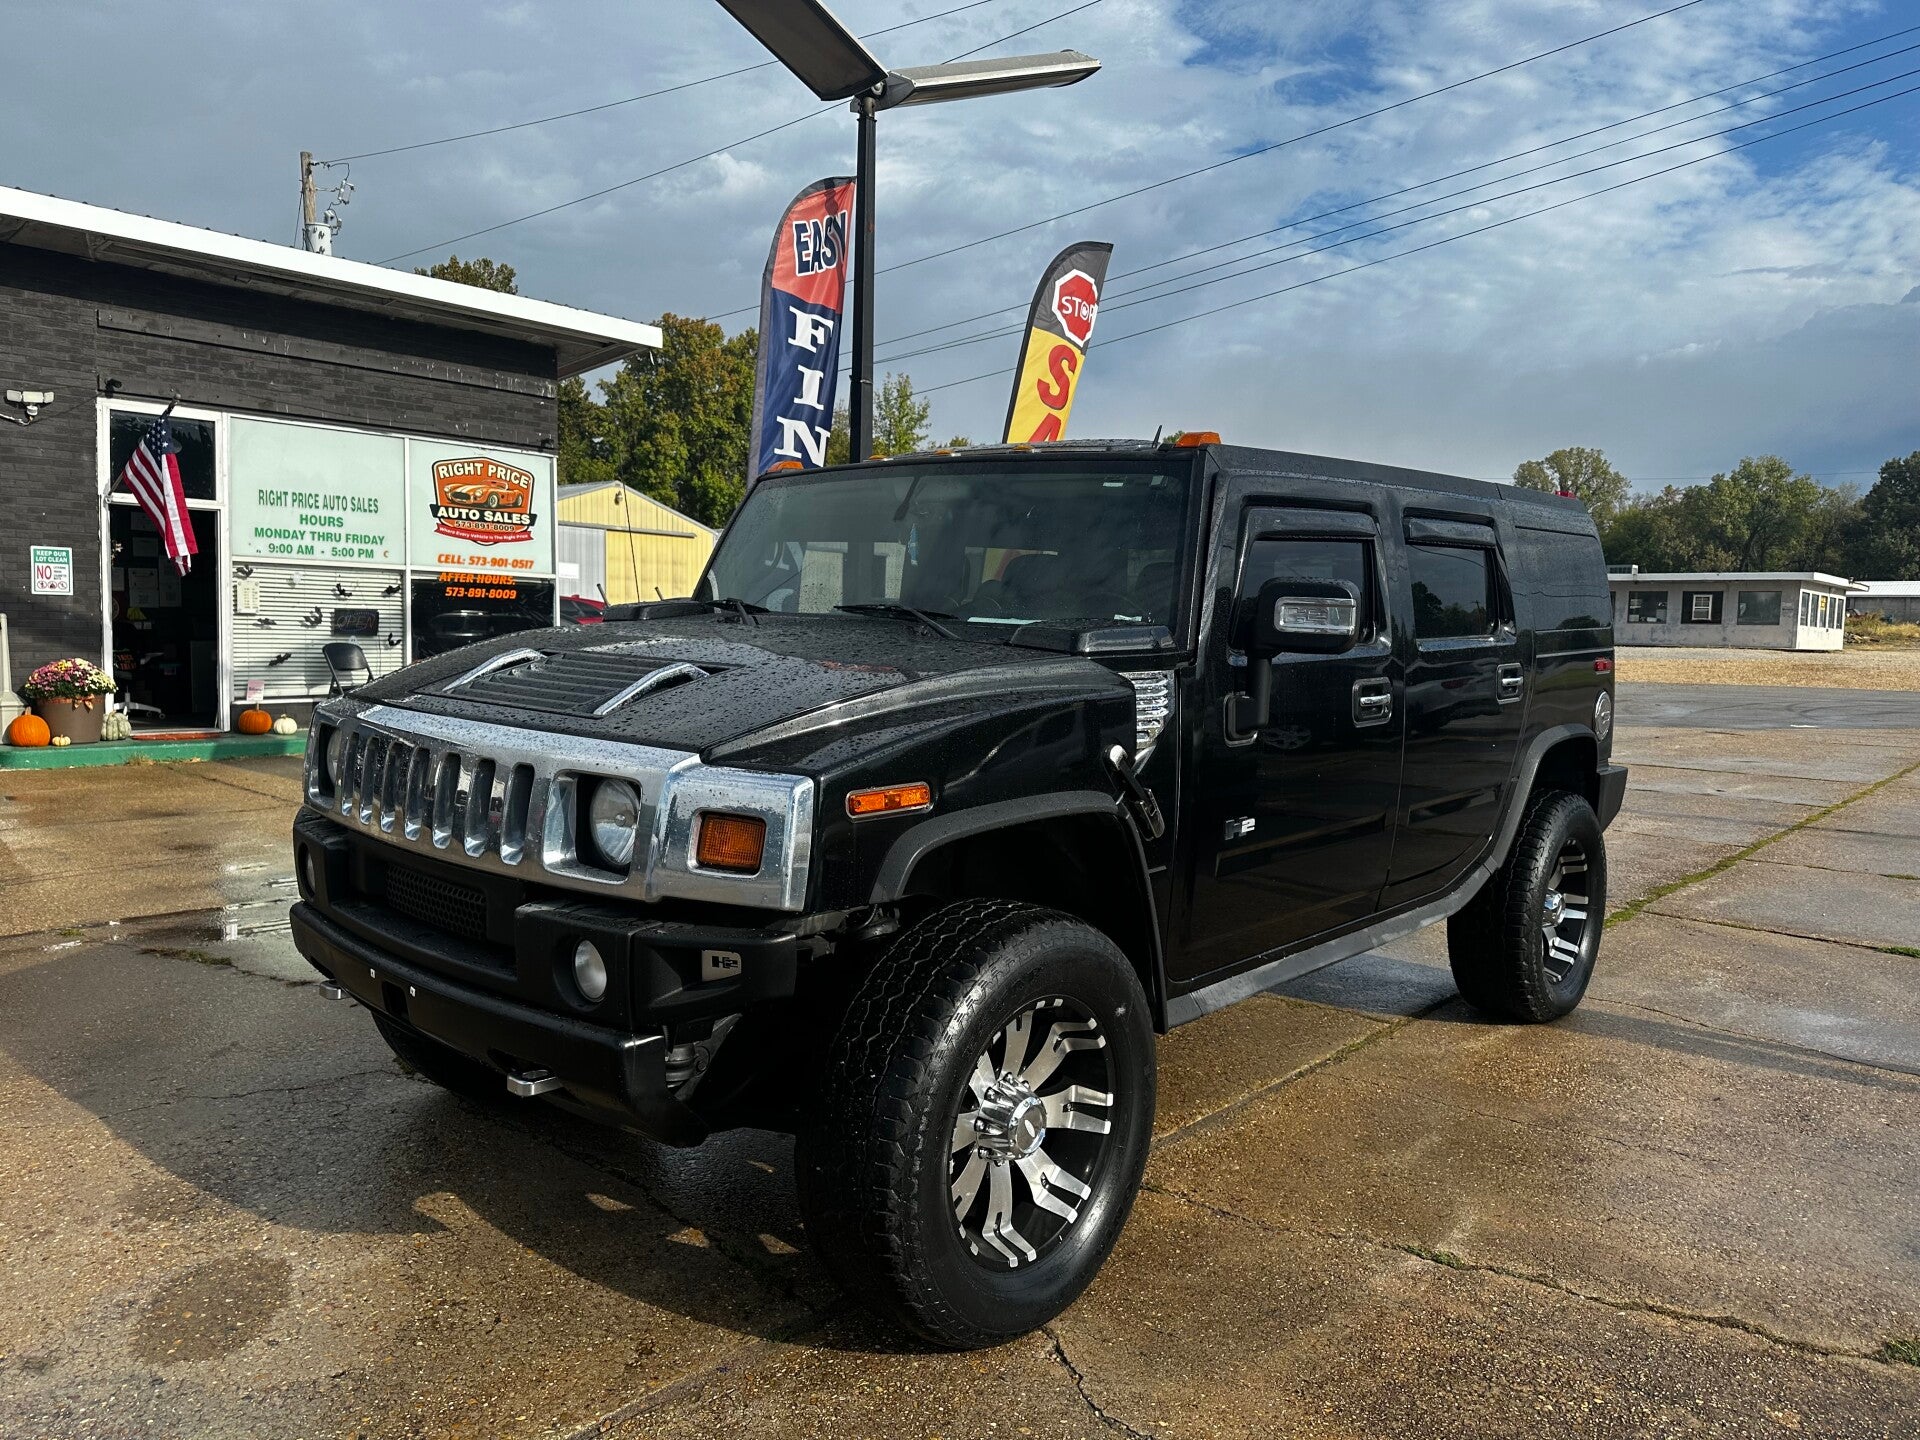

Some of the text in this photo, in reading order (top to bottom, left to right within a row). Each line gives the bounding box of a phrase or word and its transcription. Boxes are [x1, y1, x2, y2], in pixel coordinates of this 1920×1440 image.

[793, 210, 848, 277] EASY
[1061, 296, 1097, 323] STOP
[438, 463, 530, 489] RIGHT PRICE
[258, 489, 379, 514] RIGHT PRICE AUTO SALES
[299, 514, 344, 528] HOURS
[437, 506, 530, 525] AUTO SALES
[455, 520, 515, 532] 573-891-8009
[254, 527, 385, 546] MONDAY THRU FRIDAY
[268, 543, 293, 554] 9:00
[296, 545, 315, 556] AM
[331, 546, 355, 558] 5:00
[358, 548, 375, 559] PM
[437, 554, 534, 569] CELL: 573-901-0517
[37, 565, 52, 580] NO
[439, 572, 474, 583] AFTER
[445, 586, 517, 599] 573-891-8009
[1225, 816, 1256, 840] H2
[711, 955, 739, 970] H2
